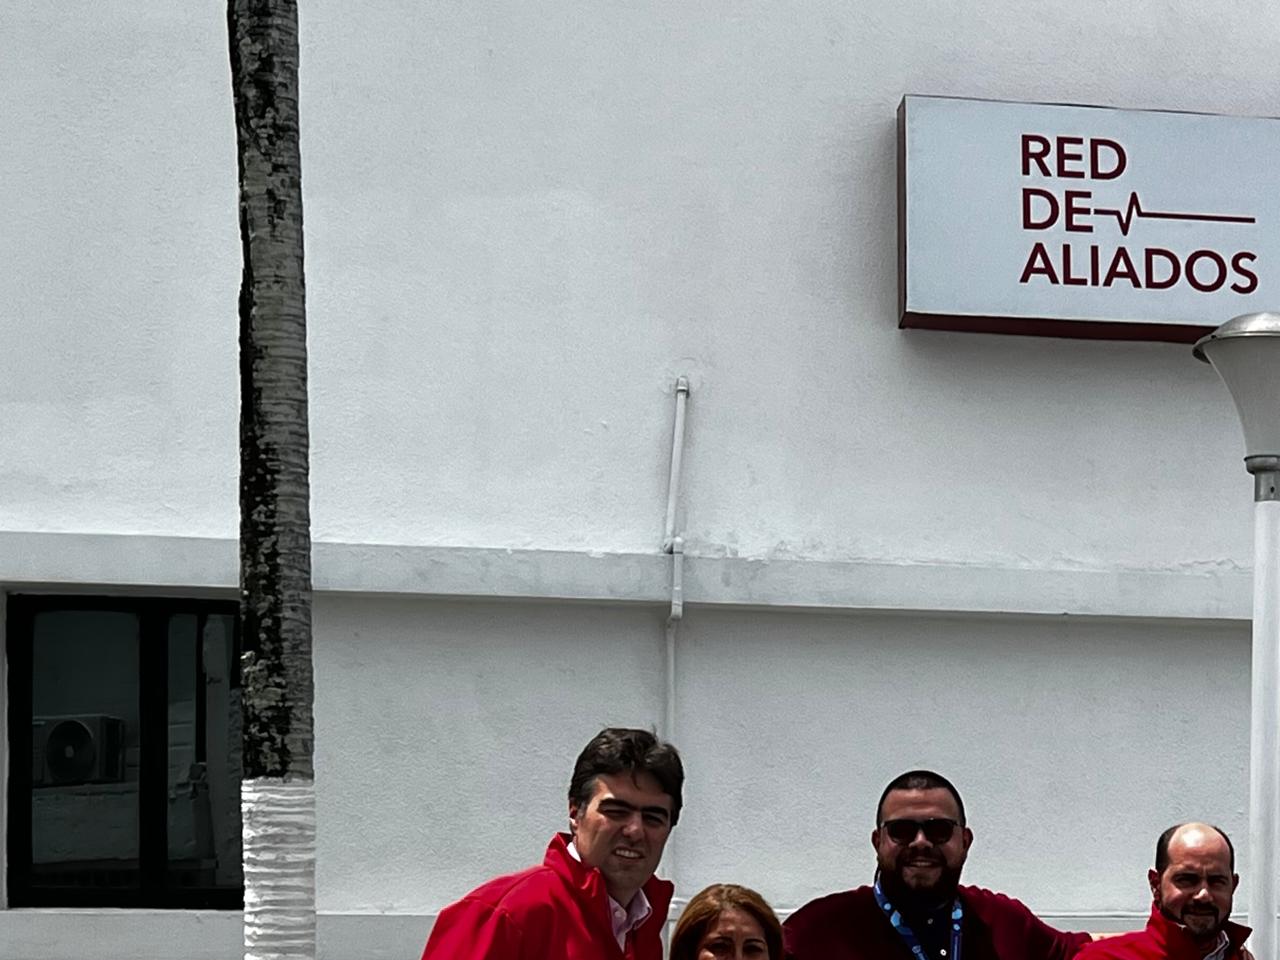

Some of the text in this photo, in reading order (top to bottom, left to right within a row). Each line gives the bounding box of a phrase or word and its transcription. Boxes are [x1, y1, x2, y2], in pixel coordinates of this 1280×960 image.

[1021, 134, 1127, 181] RED
[1022, 187, 1094, 233] DE
[1019, 242, 1258, 295] ALIADOS
